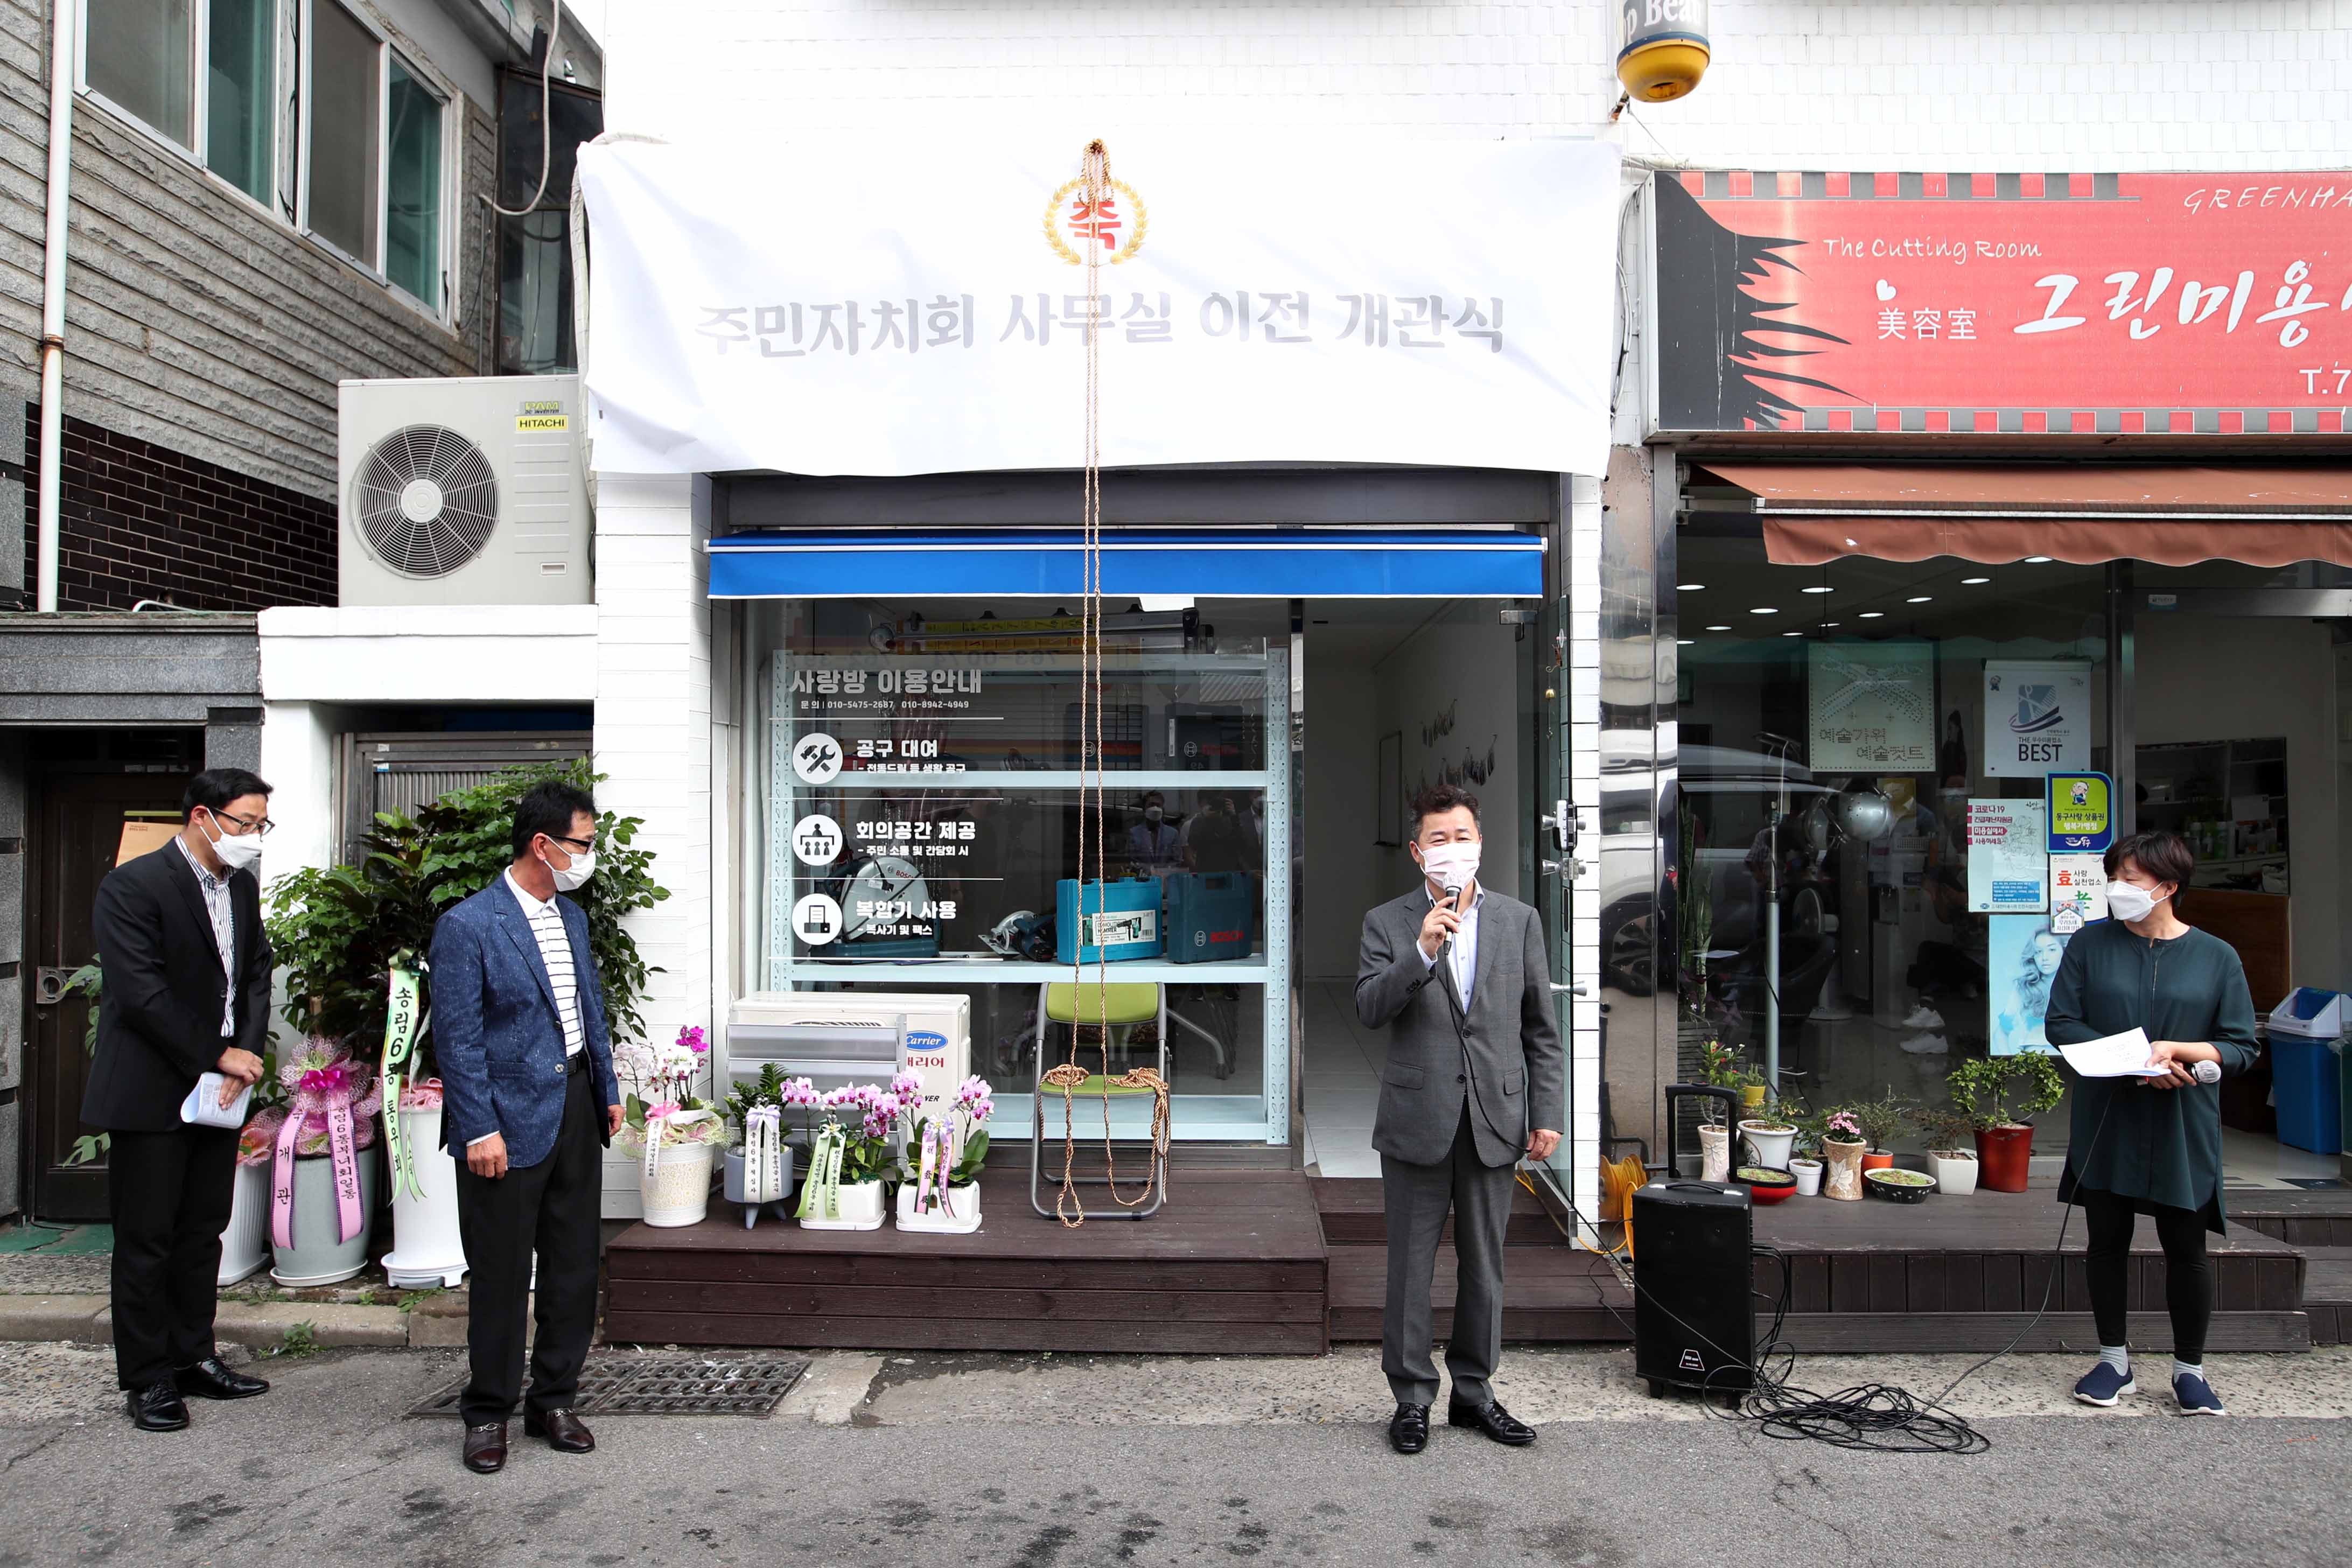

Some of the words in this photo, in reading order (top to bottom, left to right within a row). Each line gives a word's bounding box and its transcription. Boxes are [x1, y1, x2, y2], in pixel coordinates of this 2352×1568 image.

[1068, 198, 1121, 250] 축
[1823, 236, 1863, 258] The
[1871, 236, 1968, 265] Cutting
[1975, 240, 2042, 258] Room
[2013, 260, 2352, 348] 그린미용
[695, 293, 974, 358] 주민자치회
[999, 291, 1173, 346] 사무실
[1200, 290, 1313, 343] 이전
[1335, 292, 1504, 354] 개관식
[1877, 307, 1977, 340] 美容室
[525, 401, 559, 410] PAM
[520, 419, 564, 428] HITACHI
[789, 669, 867, 694] 사랑방
[878, 668, 982, 694] 이용안내
[827, 701, 893, 709] 010-5475-2687
[901, 701, 969, 709] 010-8942-4949
[856, 739, 893, 758] 공구
[901, 739, 938, 758] 대여
[2019, 744, 2063, 762] BEST
[867, 763, 908, 774] 전동드릴
[909, 763, 920, 774] 등
[946, 763, 966, 774] 공구
[1975, 805, 2005, 813] 코로나19
[2056, 813, 2082, 821] 동구사랑
[2084, 813, 2104, 821] 상품권
[856, 821, 932, 840] 회의공간
[939, 821, 976, 840] 제공
[1974, 827, 2003, 835] 미용실에서
[866, 845, 887, 856] 주민
[889, 845, 910, 856] 소통
[912, 845, 923, 856] 및
[926, 845, 956, 856] 간담회
[958, 845, 969, 856] 시
[2056, 870, 2073, 886] 효
[856, 900, 912, 919] 복합기
[919, 900, 957, 919] 사용
[866, 925, 897, 935] 복사기
[899, 925, 910, 935] 및
[912, 925, 933, 935] 팩스
[1210, 930, 1244, 943] BOSCH
[384, 986, 413, 1085] 송림6동
[906, 1035, 942, 1045] Carrier
